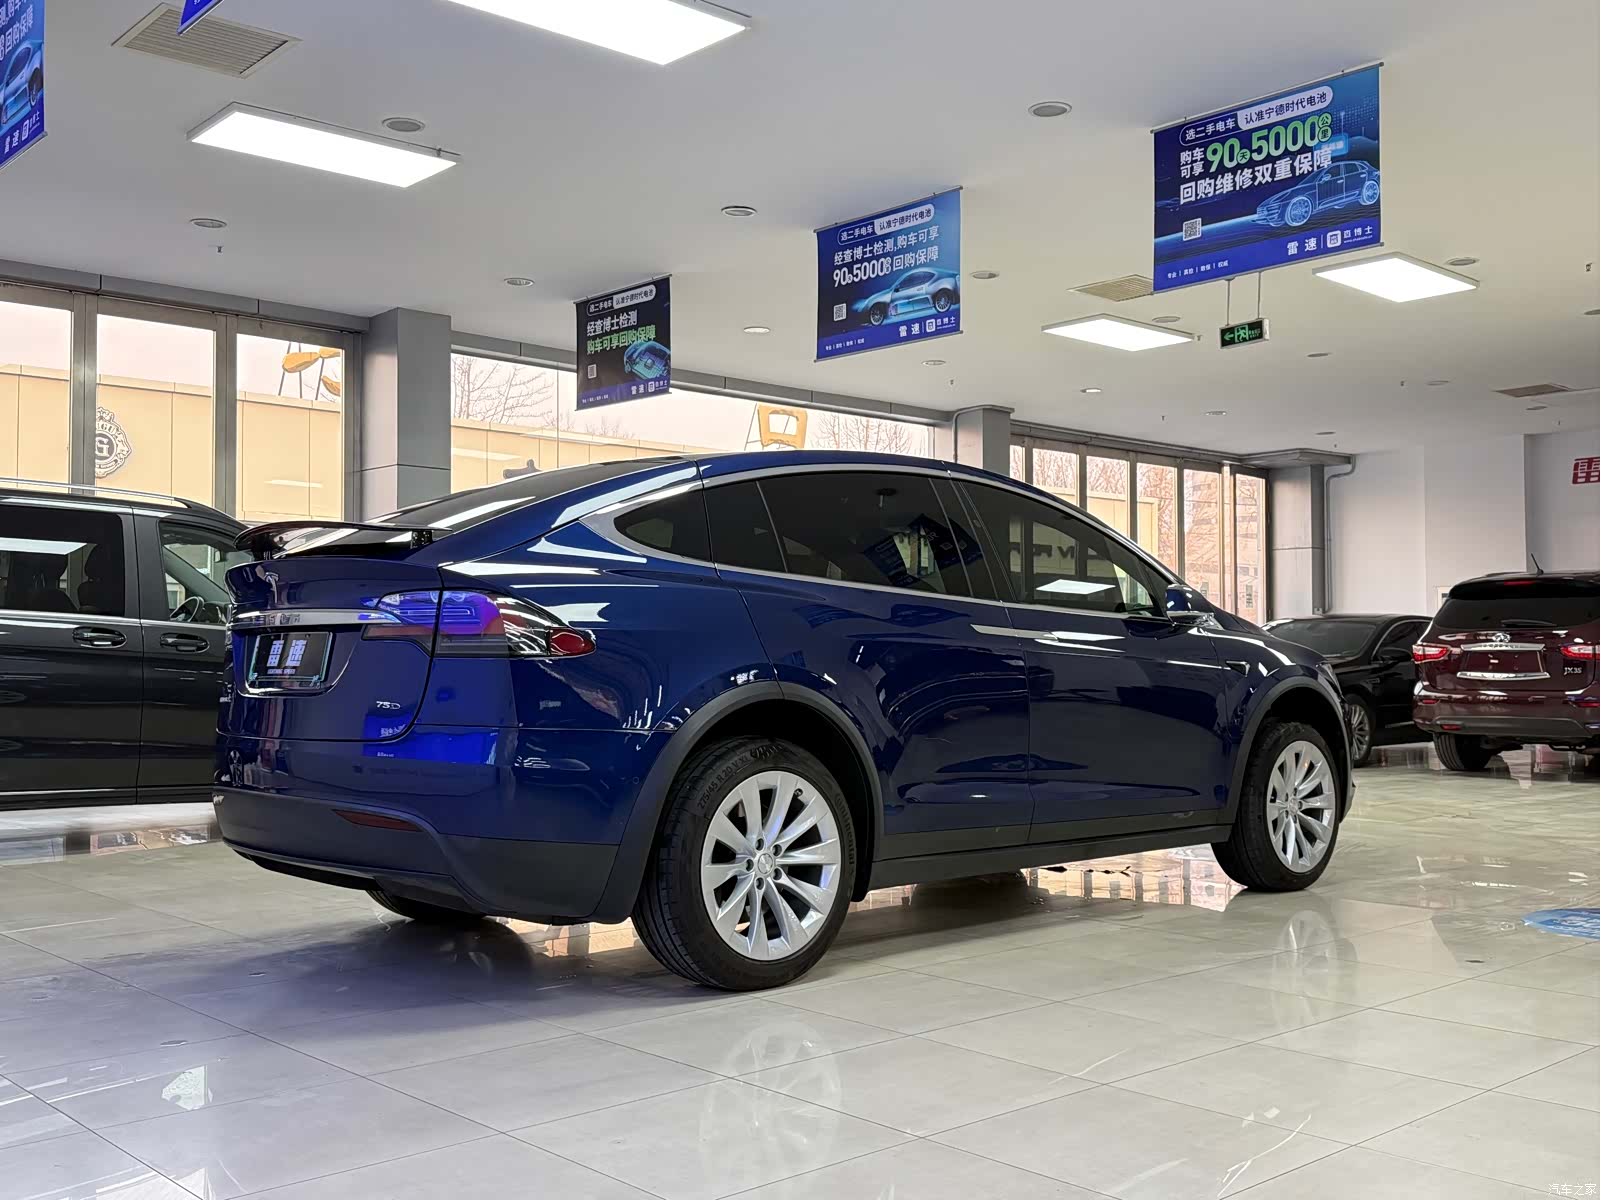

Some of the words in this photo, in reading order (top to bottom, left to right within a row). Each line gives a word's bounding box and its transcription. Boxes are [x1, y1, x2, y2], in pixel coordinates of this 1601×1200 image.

[1185, 118, 1236, 141] 选二手电车
[1244, 91, 1327, 125] 认准宁德时代电池
[1180, 147, 1205, 165] 购车
[1180, 161, 1205, 179] 可享
[1180, 148, 1333, 205] 回购维修双重保障
[840, 225, 874, 241] 选二手电车
[879, 208, 932, 231] 认准宁德时代电池
[1287, 237, 1318, 256] 雷速
[587, 309, 638, 337] 经查博士检测
[899, 322, 920, 337] 雷速
[587, 324, 656, 355] 购车可享回购保障
[266, 639, 308, 667] 雷速
[376, 700, 401, 710] 75D
[697, 781, 718, 809] 275/45
